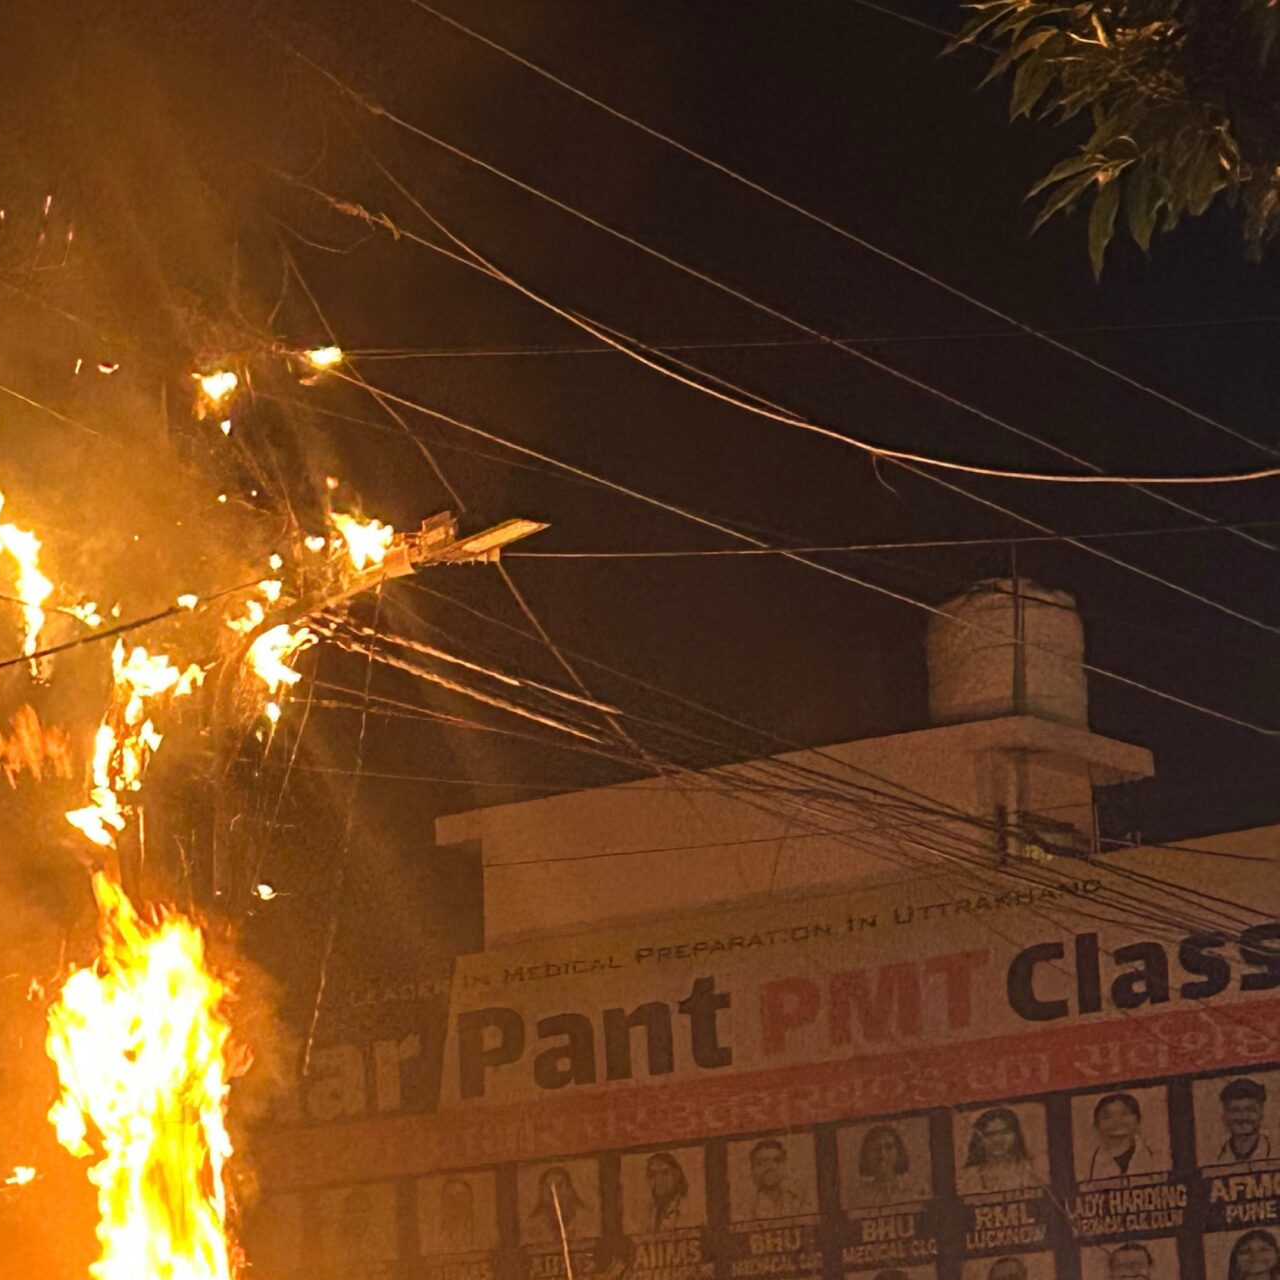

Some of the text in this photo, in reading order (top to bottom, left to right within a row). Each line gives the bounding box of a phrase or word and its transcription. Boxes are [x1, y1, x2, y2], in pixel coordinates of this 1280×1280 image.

[503, 956, 624, 982] MEDICAL
[635, 922, 833, 966] PREPARATION
[847, 913, 877, 933] IN
[307, 920, 1280, 1122] ar Pant PMT Class
[1065, 1184, 1188, 1219] LADY HARDING
[1225, 1200, 1278, 1224] PUNE
[861, 1215, 916, 1243] BHU
[974, 1202, 1036, 1230] RML
[749, 1227, 803, 1255] BHU
[965, 1224, 1047, 1250] LUCKNOW
[634, 1240, 702, 1269] AIIMS
